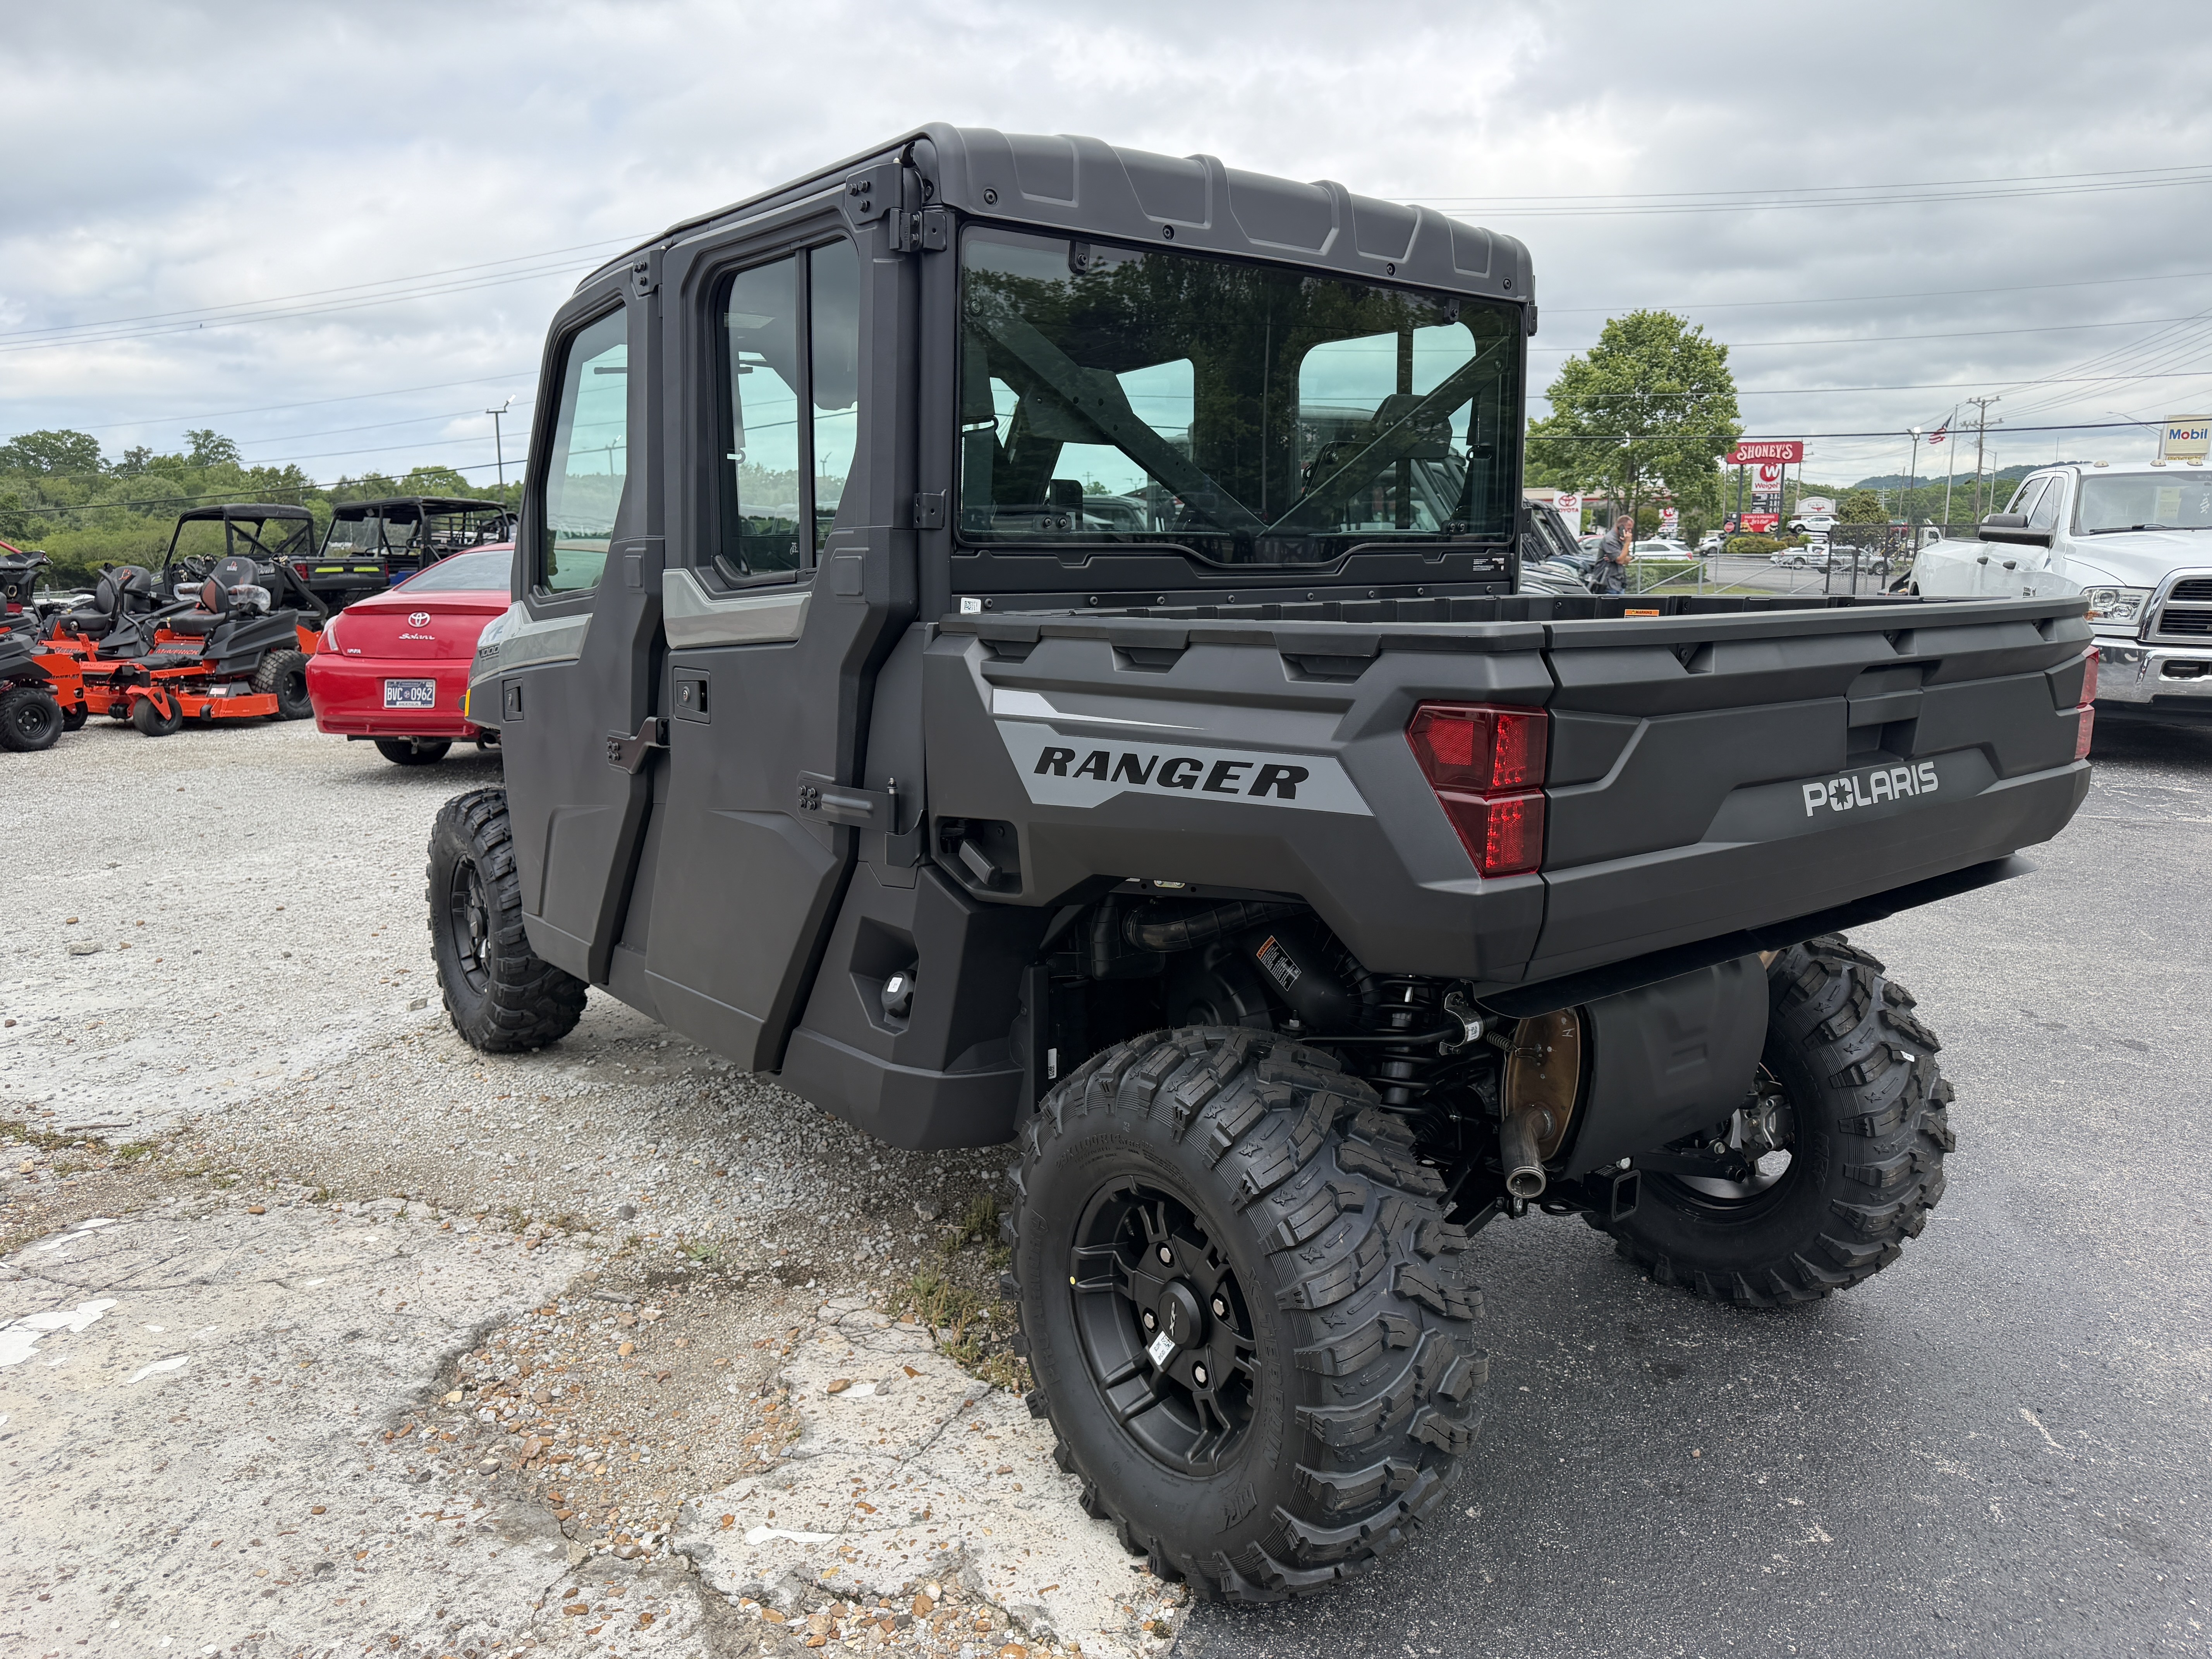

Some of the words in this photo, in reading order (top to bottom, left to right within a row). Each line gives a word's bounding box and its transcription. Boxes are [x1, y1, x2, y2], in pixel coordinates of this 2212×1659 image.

[2169, 428, 2208, 440] Mobil
[1736, 444, 1793, 461] SHONEY'S
[481, 646, 500, 657] 1000
[387, 687, 403, 701] BVC
[411, 687, 433, 701] 0962
[1033, 746, 1309, 800] RANGER
[1802, 761, 1939, 817] POLARIS
[1169, 1302, 1177, 1337] XP
[1243, 1266, 1284, 1472] X-TERRAIN
